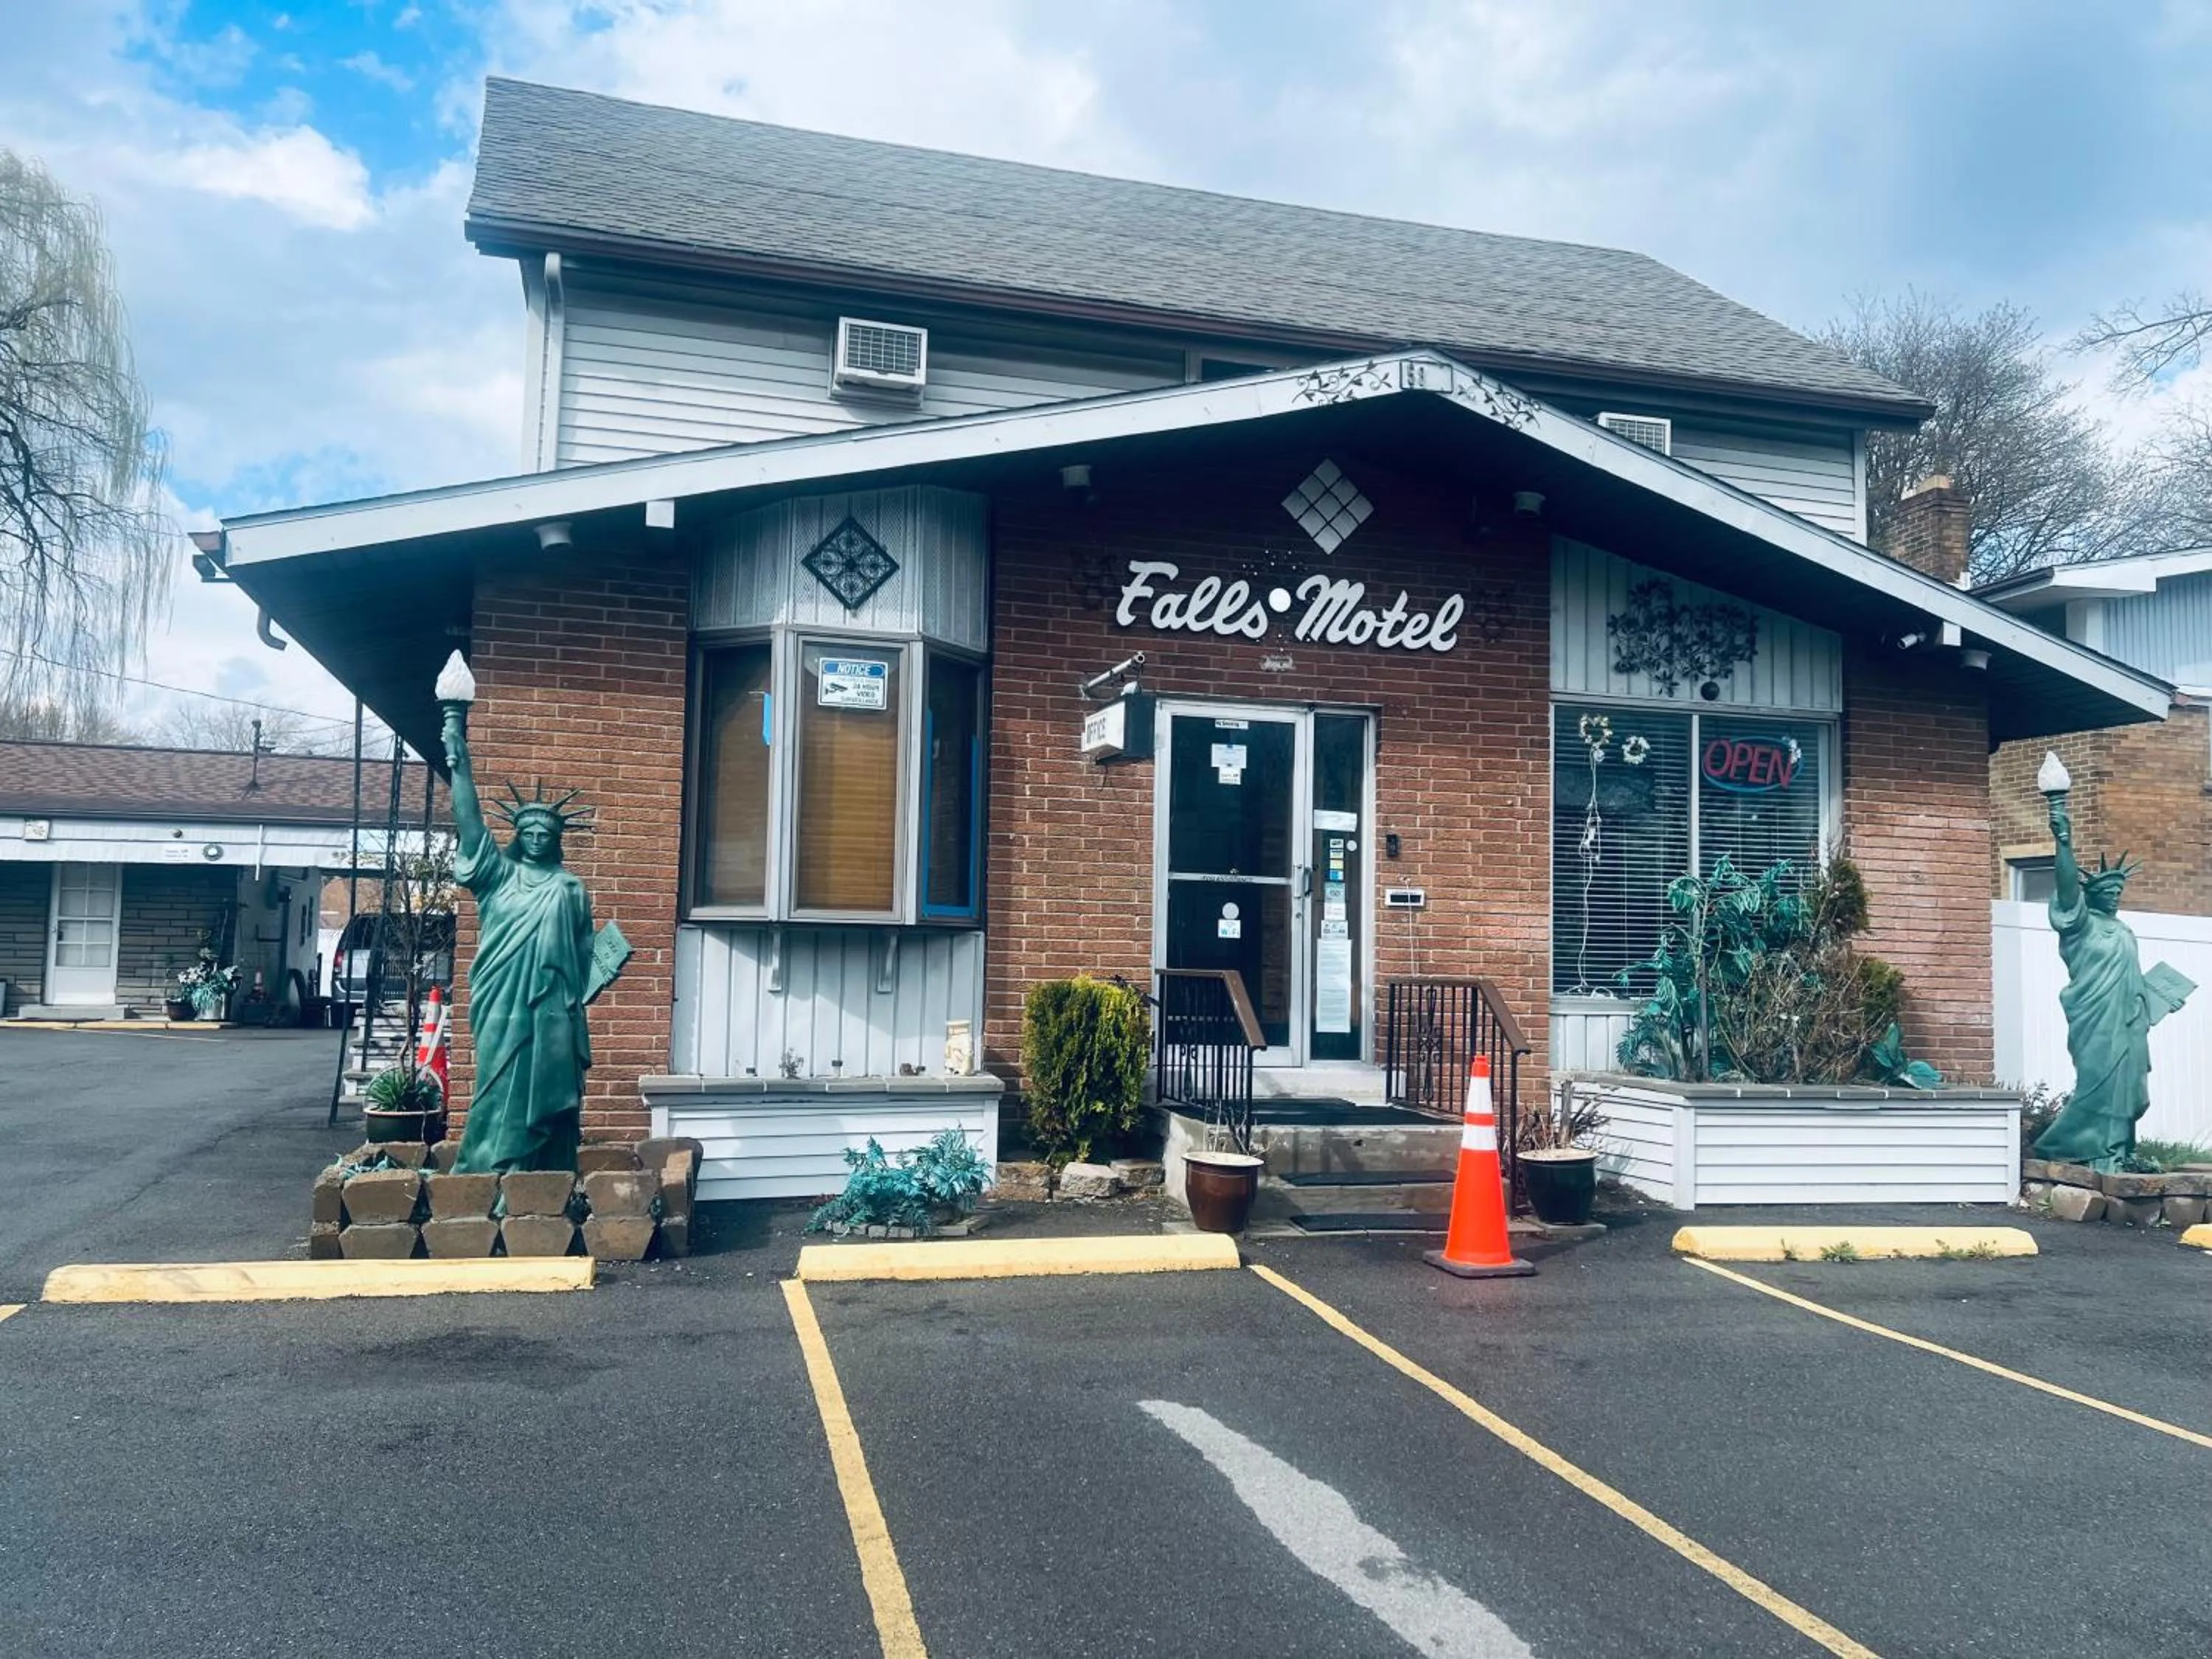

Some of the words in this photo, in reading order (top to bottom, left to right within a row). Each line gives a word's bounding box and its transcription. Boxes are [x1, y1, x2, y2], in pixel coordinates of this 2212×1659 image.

[1116, 560, 1269, 639] Falls
[1294, 574, 1464, 652] Motel
[1704, 739, 1792, 787] OPEN
